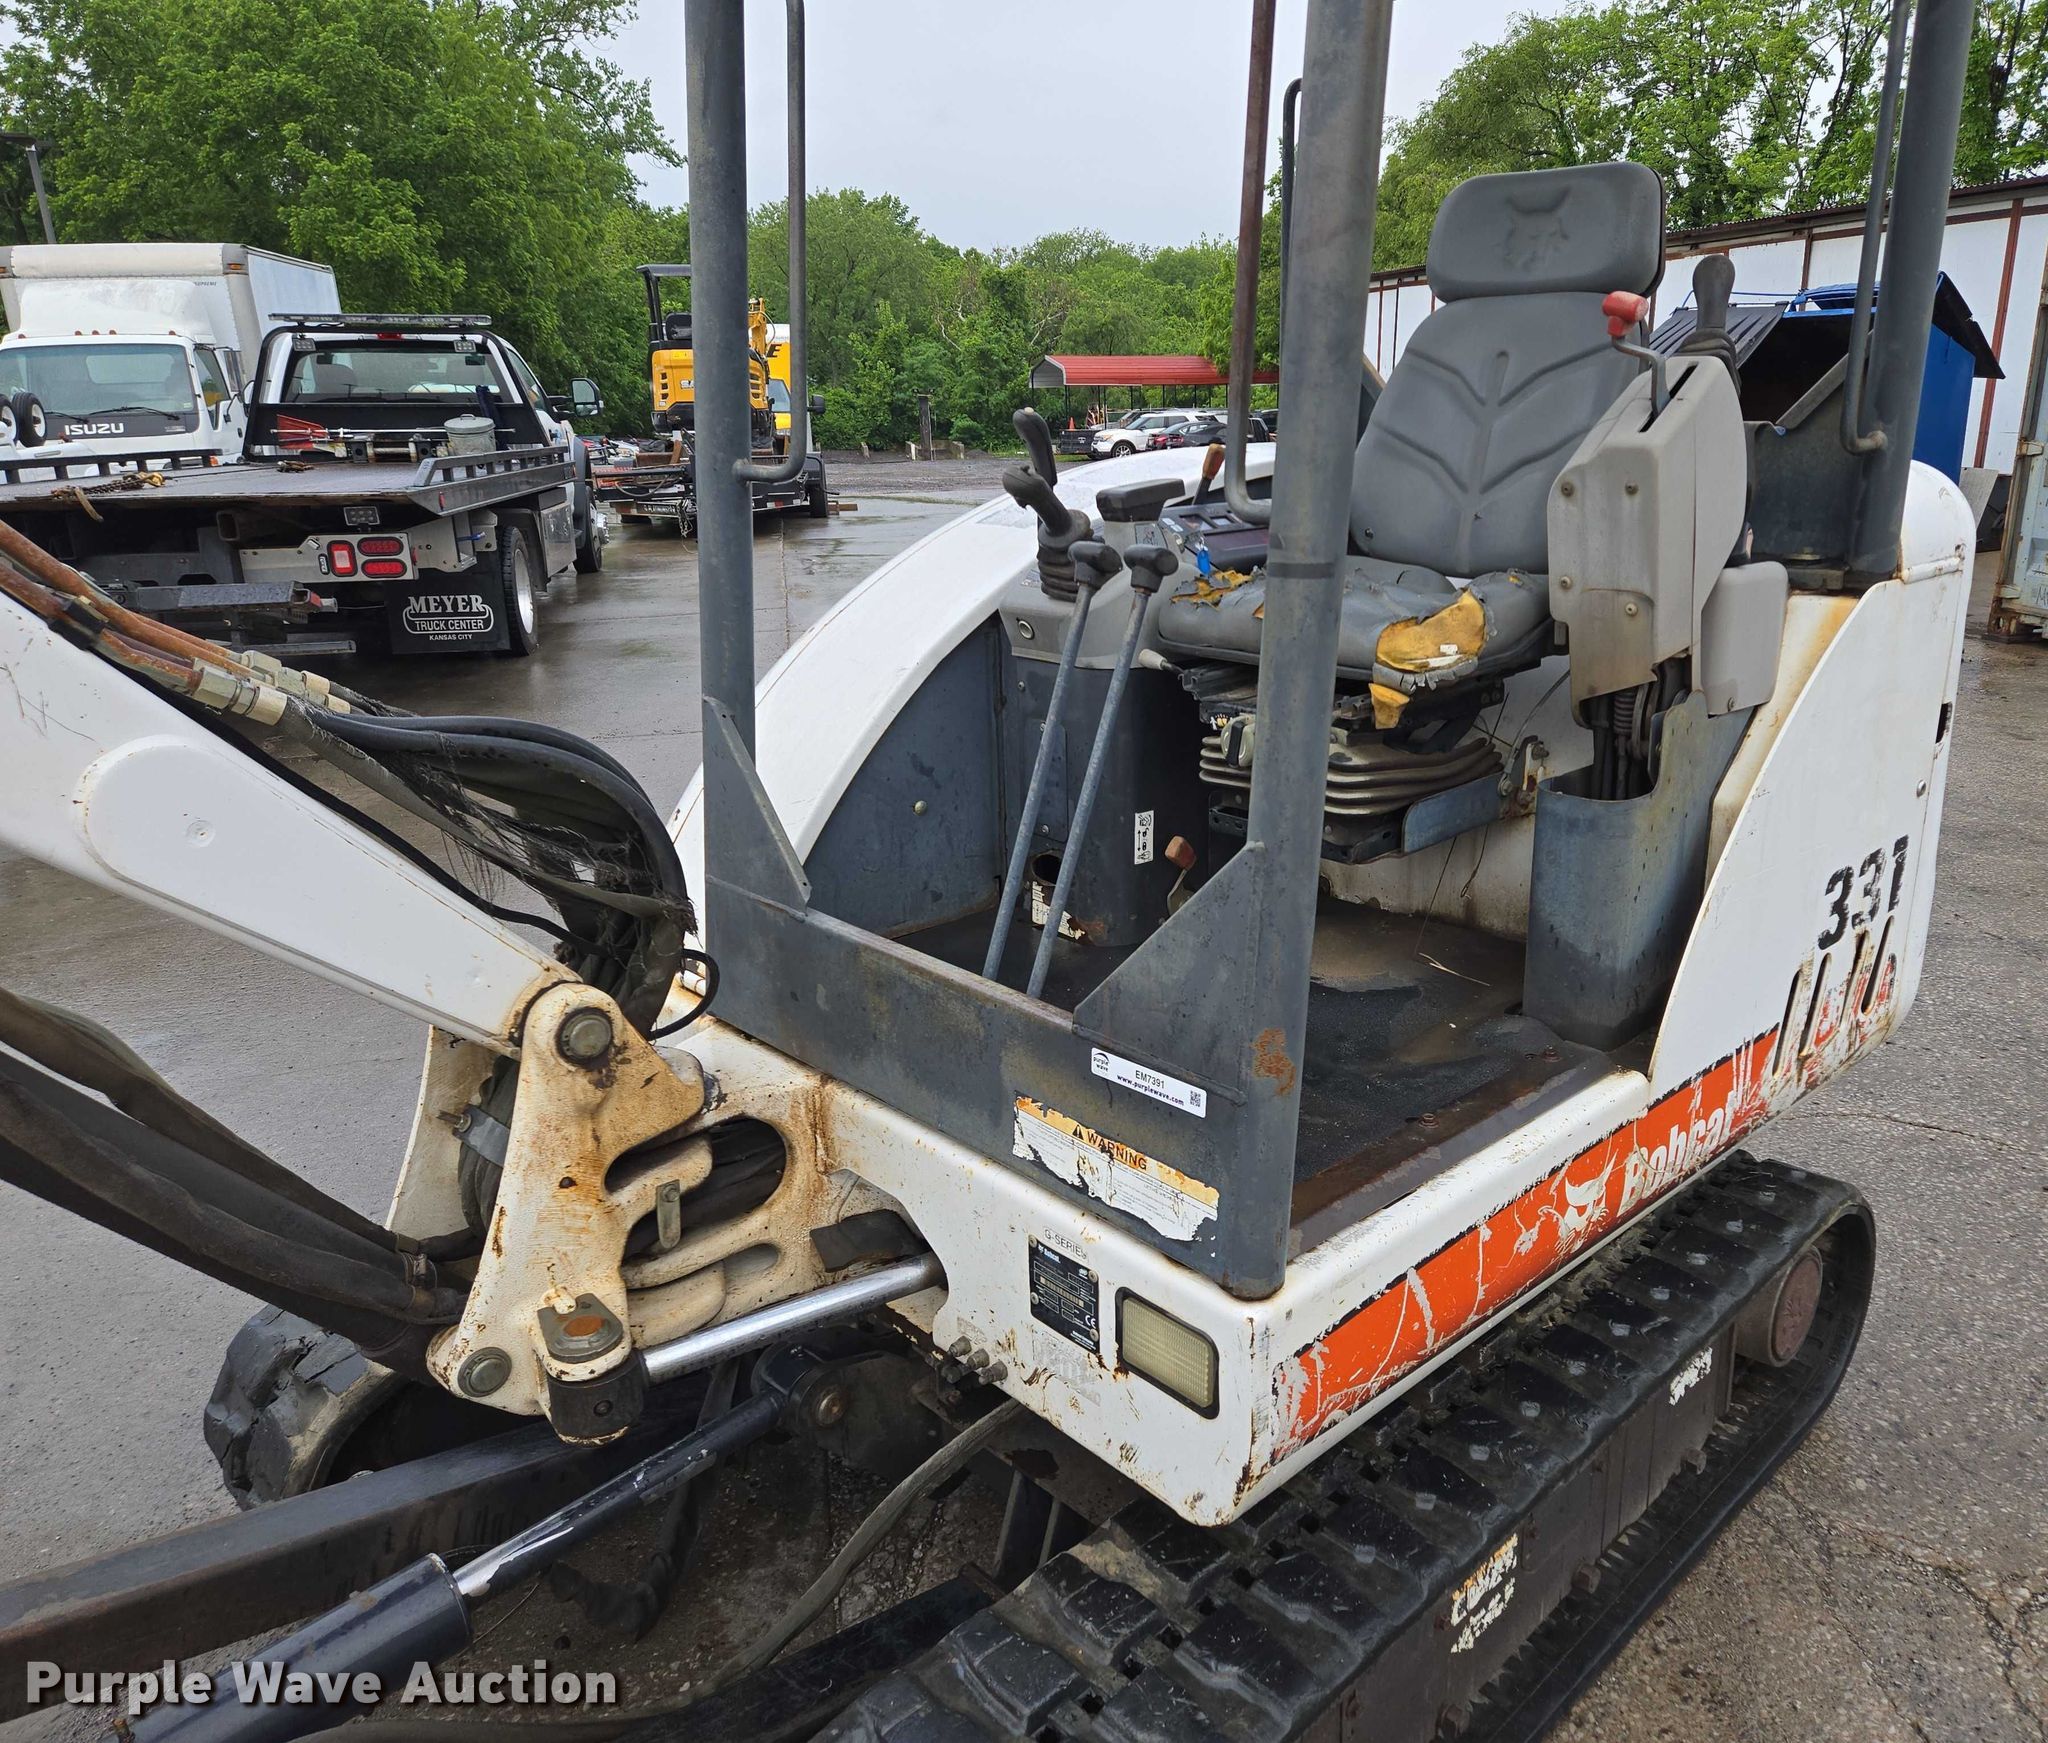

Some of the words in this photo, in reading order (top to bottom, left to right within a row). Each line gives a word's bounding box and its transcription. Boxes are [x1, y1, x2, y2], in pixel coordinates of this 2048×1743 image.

[64, 422, 125, 436] ISUZU
[407, 594, 486, 614] MEYER
[414, 620, 447, 631] TRUCK
[447, 619, 485, 630] CENTER
[1817, 834, 1909, 951] 331
[1116, 1074, 1185, 1107] www.purplewave.com
[1135, 1069, 1165, 1089] EM7391
[1087, 1130, 1147, 1171] WARNING
[1616, 1090, 1738, 1218] Bobcat
[1044, 1228, 1088, 1260] G-SERIES
